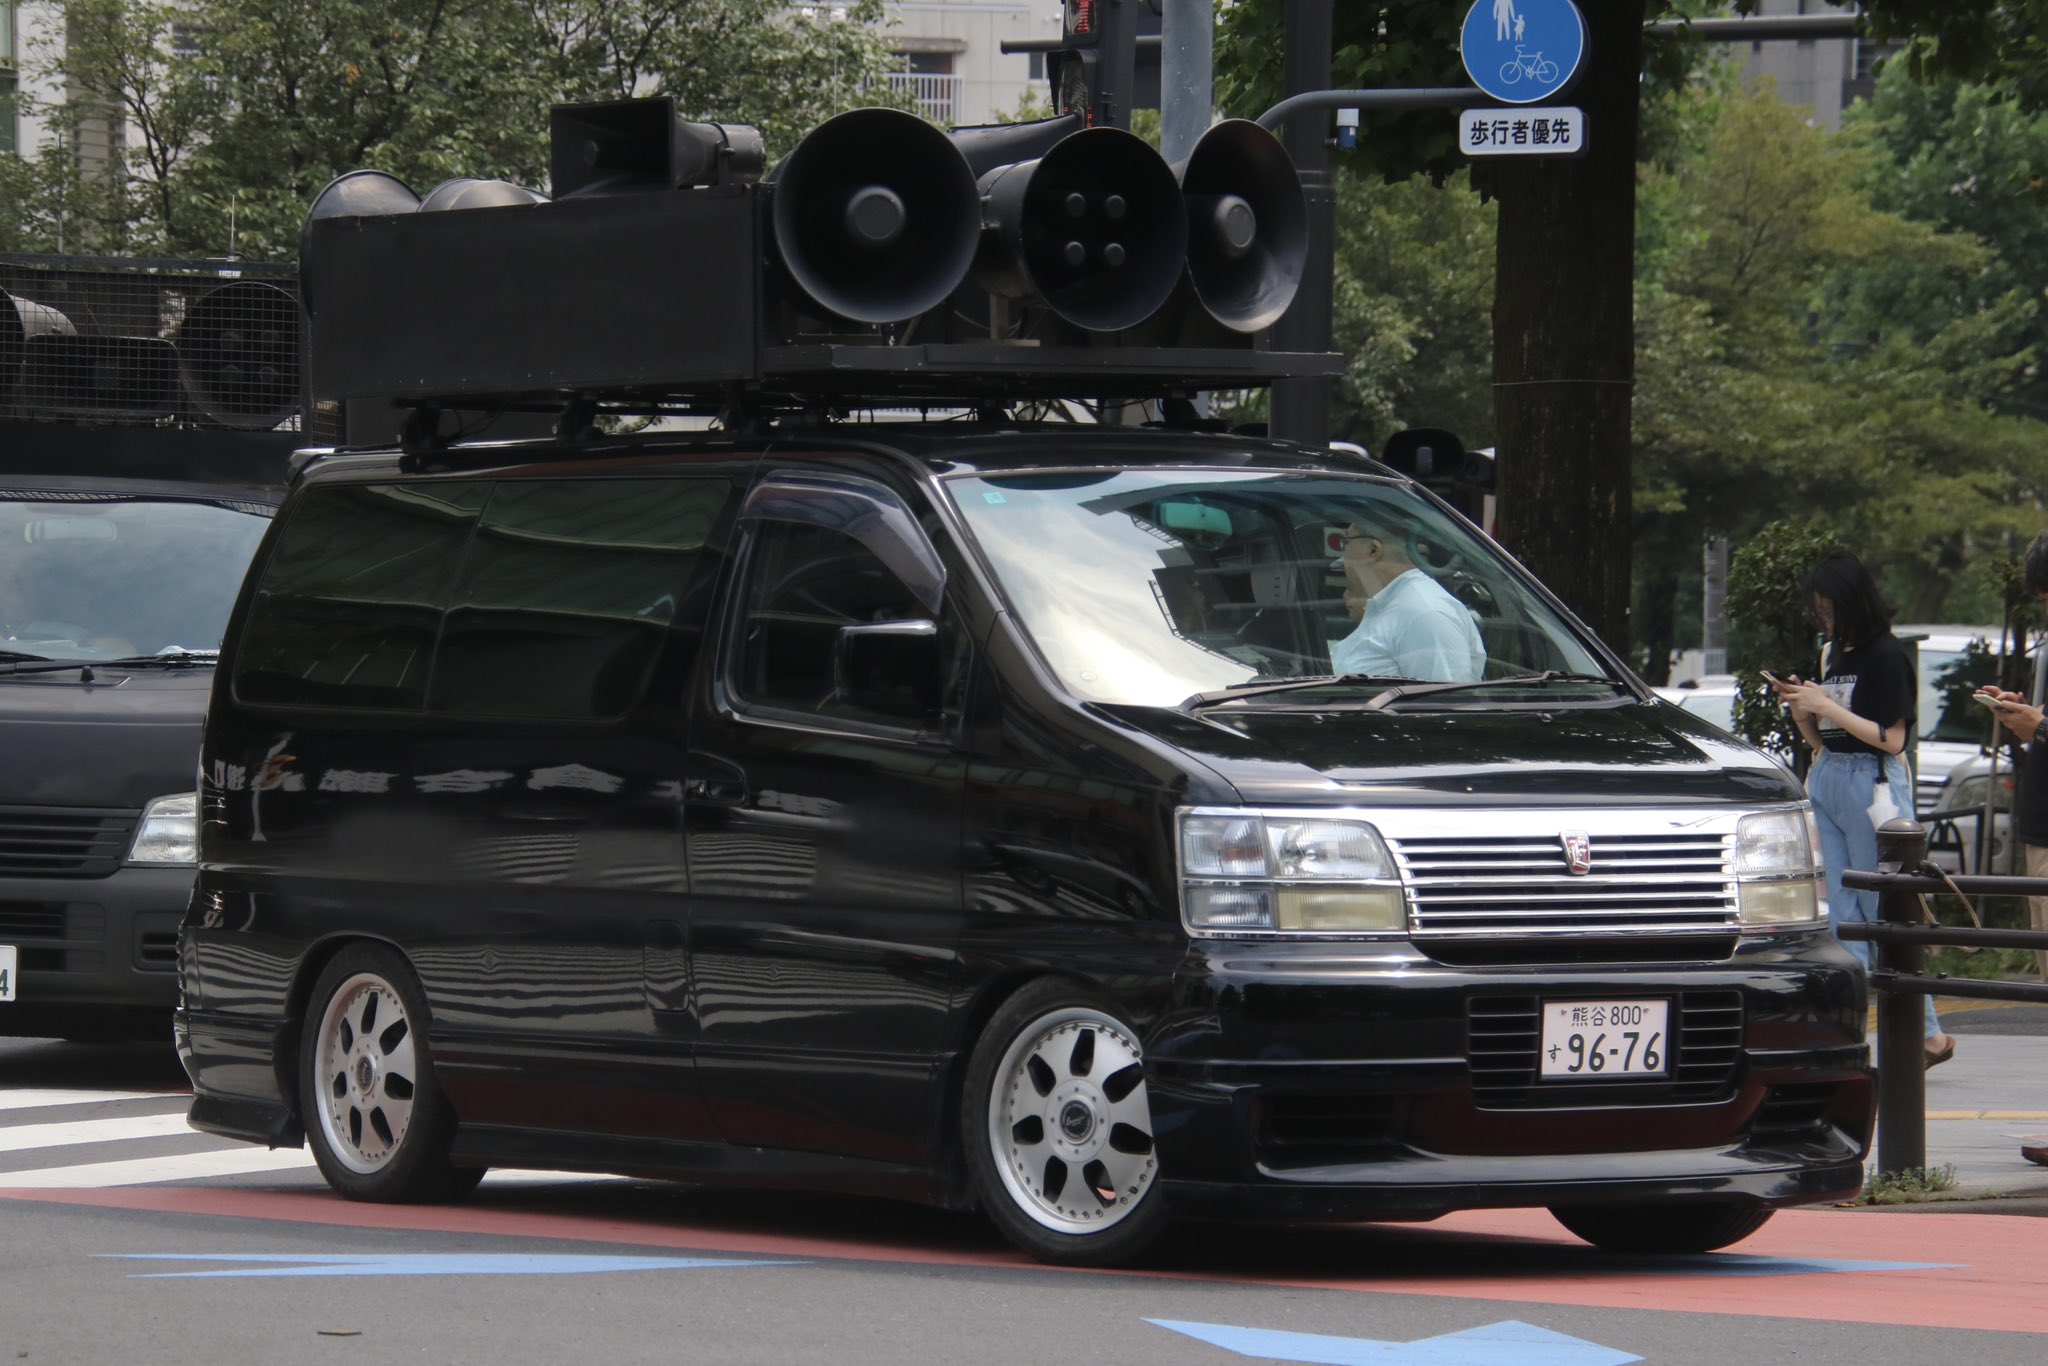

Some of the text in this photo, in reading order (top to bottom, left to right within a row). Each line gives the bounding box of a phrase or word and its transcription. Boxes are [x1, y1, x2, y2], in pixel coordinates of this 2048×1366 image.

[1470, 118, 1570, 146] 歩行者優先
[1567, 1031, 1661, 1072] 96-76
